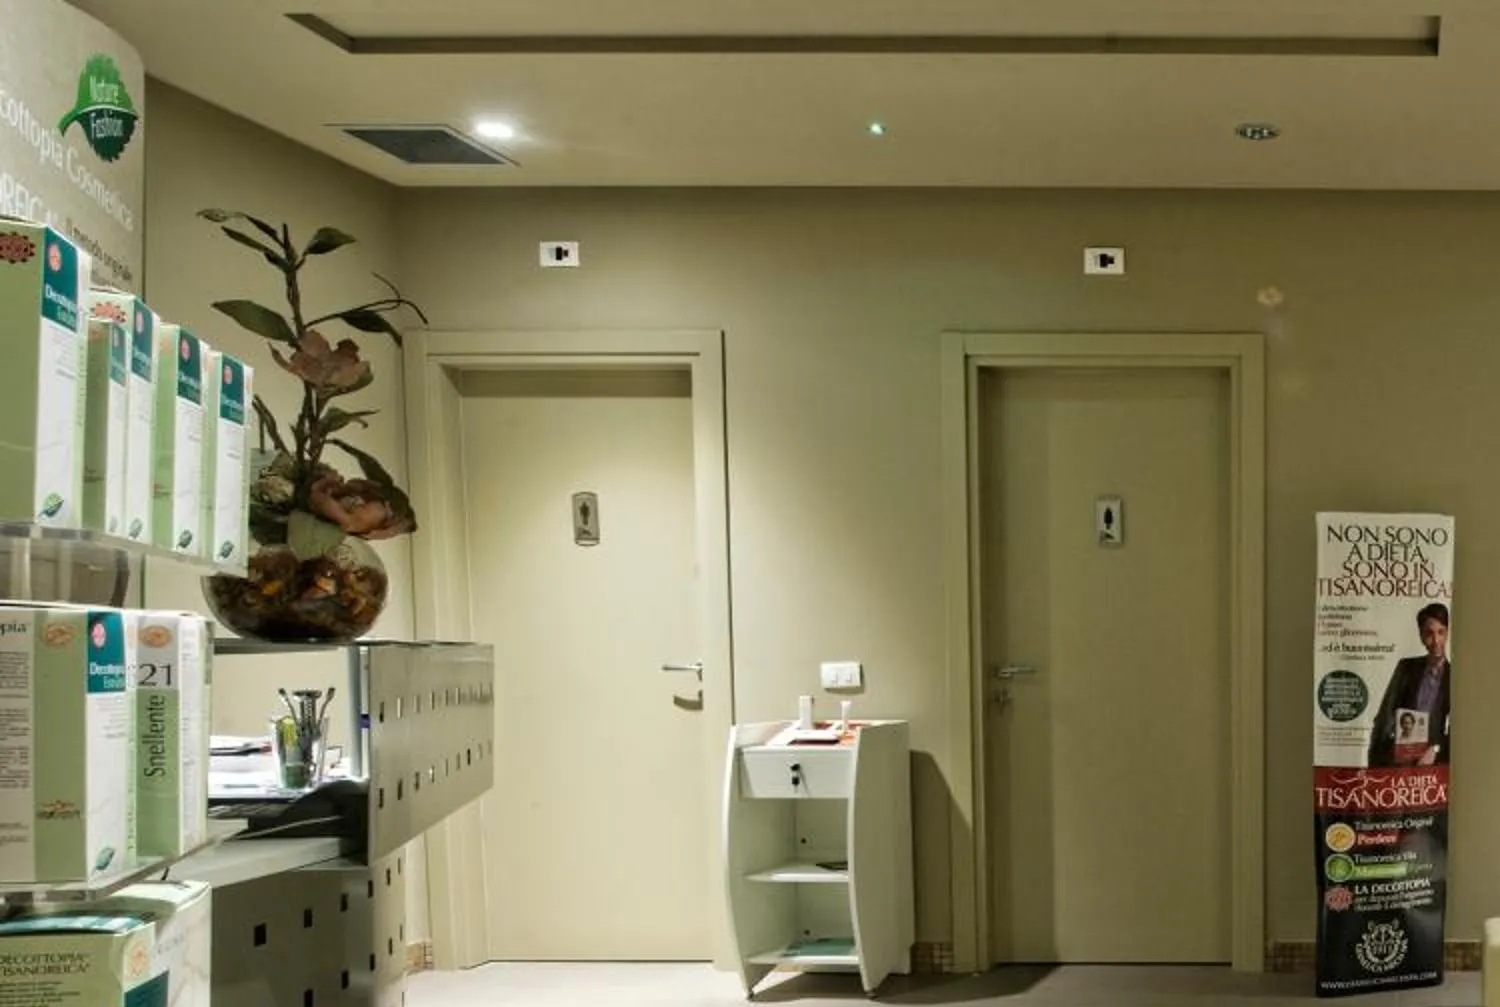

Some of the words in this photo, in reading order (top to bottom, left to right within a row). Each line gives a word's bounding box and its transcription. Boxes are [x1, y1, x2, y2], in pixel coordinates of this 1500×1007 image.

[1327, 525, 1379, 544] NON
[1385, 526, 1448, 547] SONO
[1349, 544, 1363, 561] A
[1342, 560, 1408, 580] SONO
[1412, 561, 1436, 579] IN
[138, 663, 173, 687] 21
[1391, 776, 1405, 788] LA
[1316, 784, 1448, 809] TISANOREICA
[1355, 884, 1369, 895] LA
